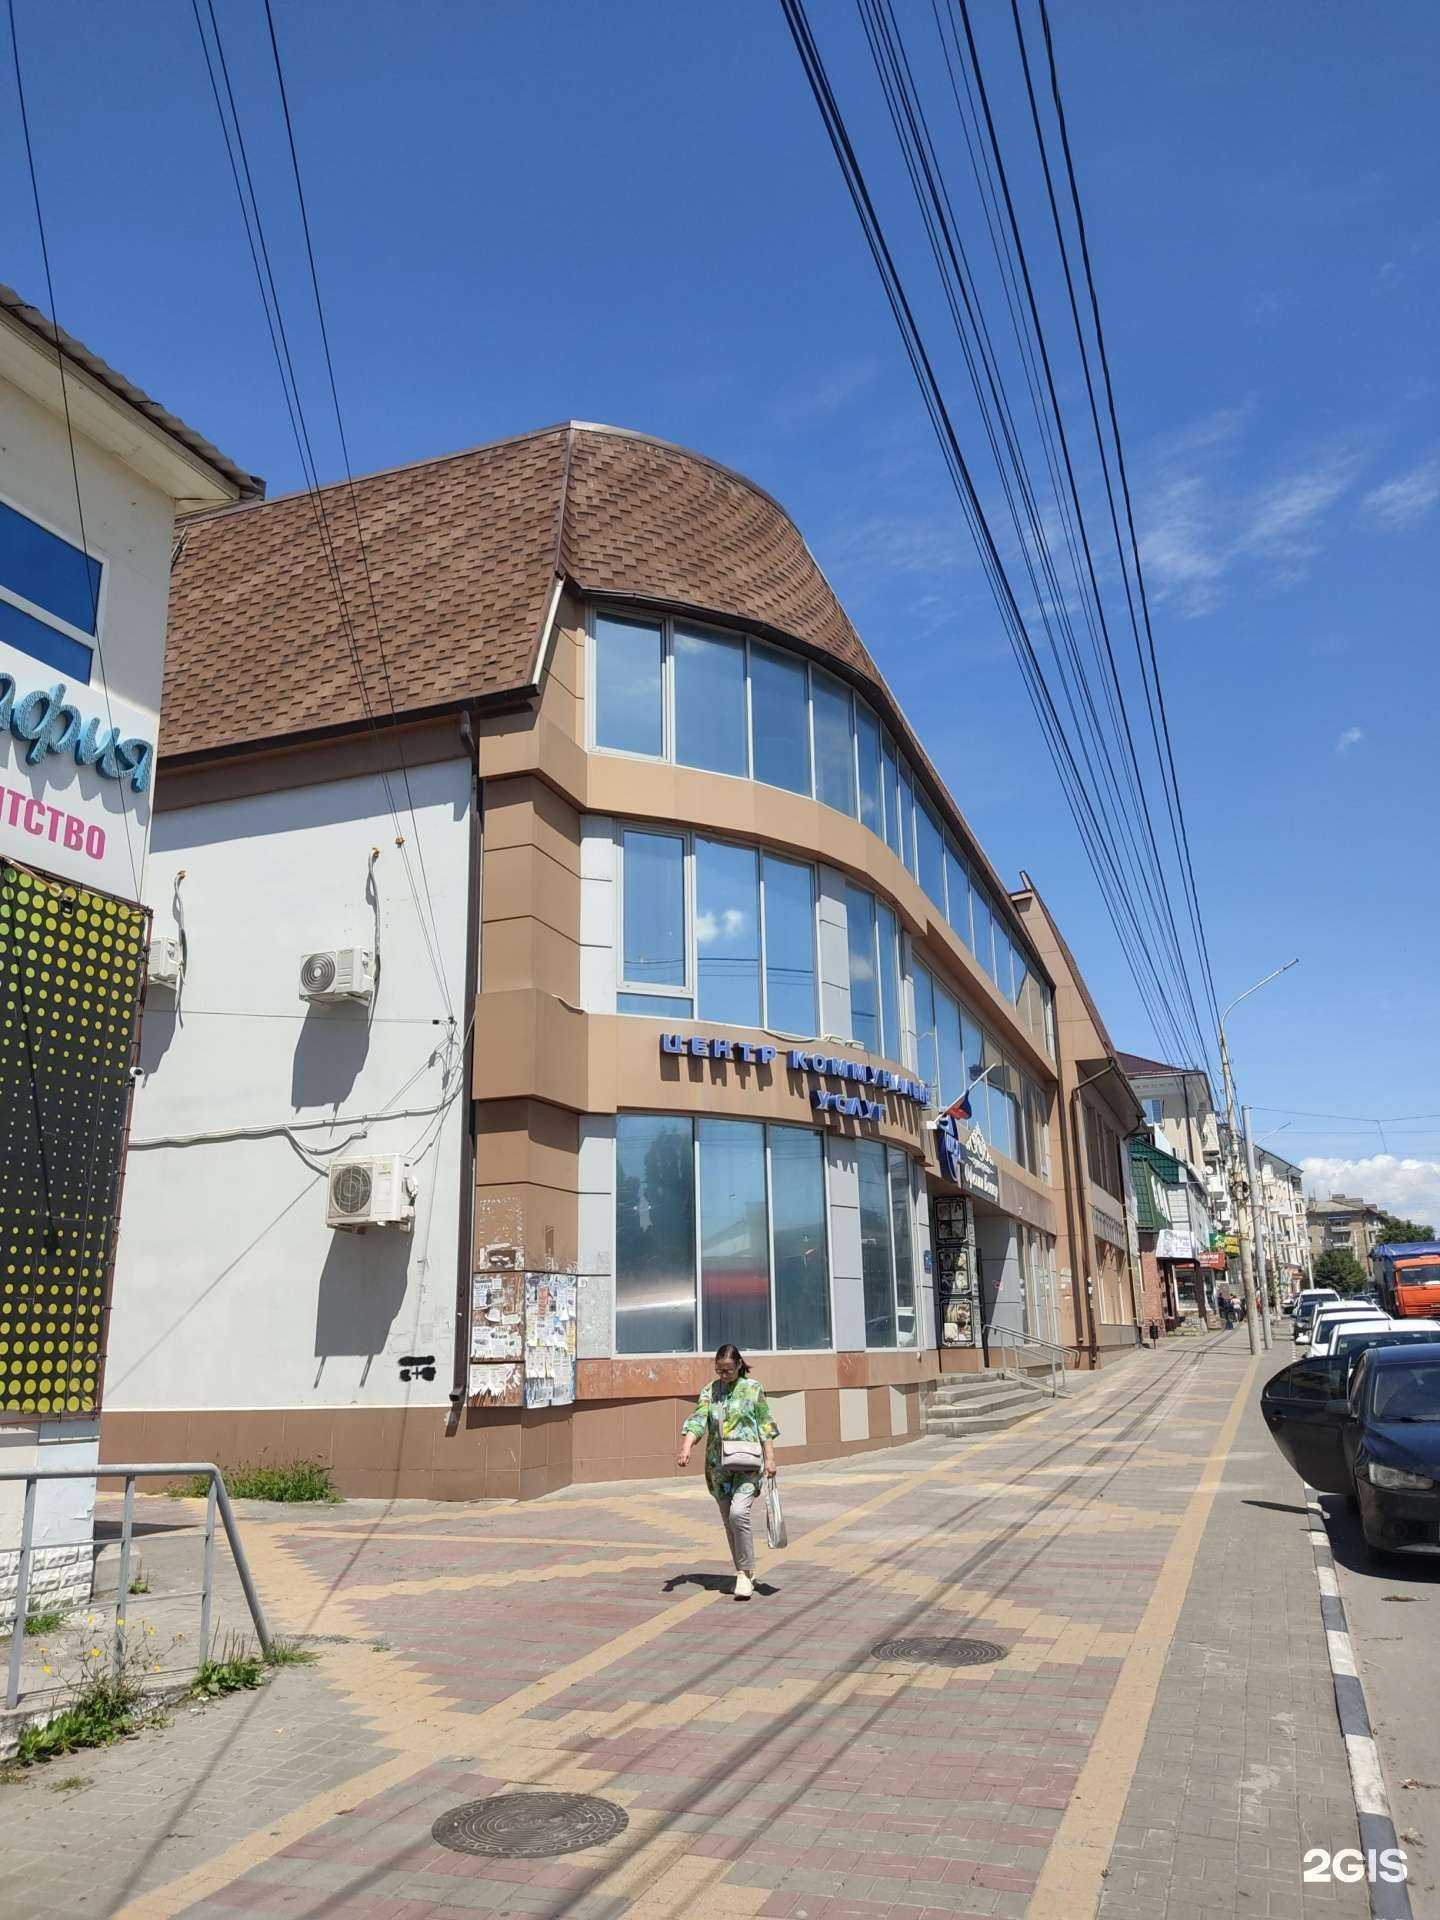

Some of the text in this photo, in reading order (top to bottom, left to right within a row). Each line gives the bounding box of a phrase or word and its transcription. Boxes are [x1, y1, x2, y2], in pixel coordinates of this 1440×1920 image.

[0, 785, 106, 860] ТСТВО
[660, 1032, 777, 1065] ЦЕНТР
[814, 1088, 887, 1122] УСЛУГ
